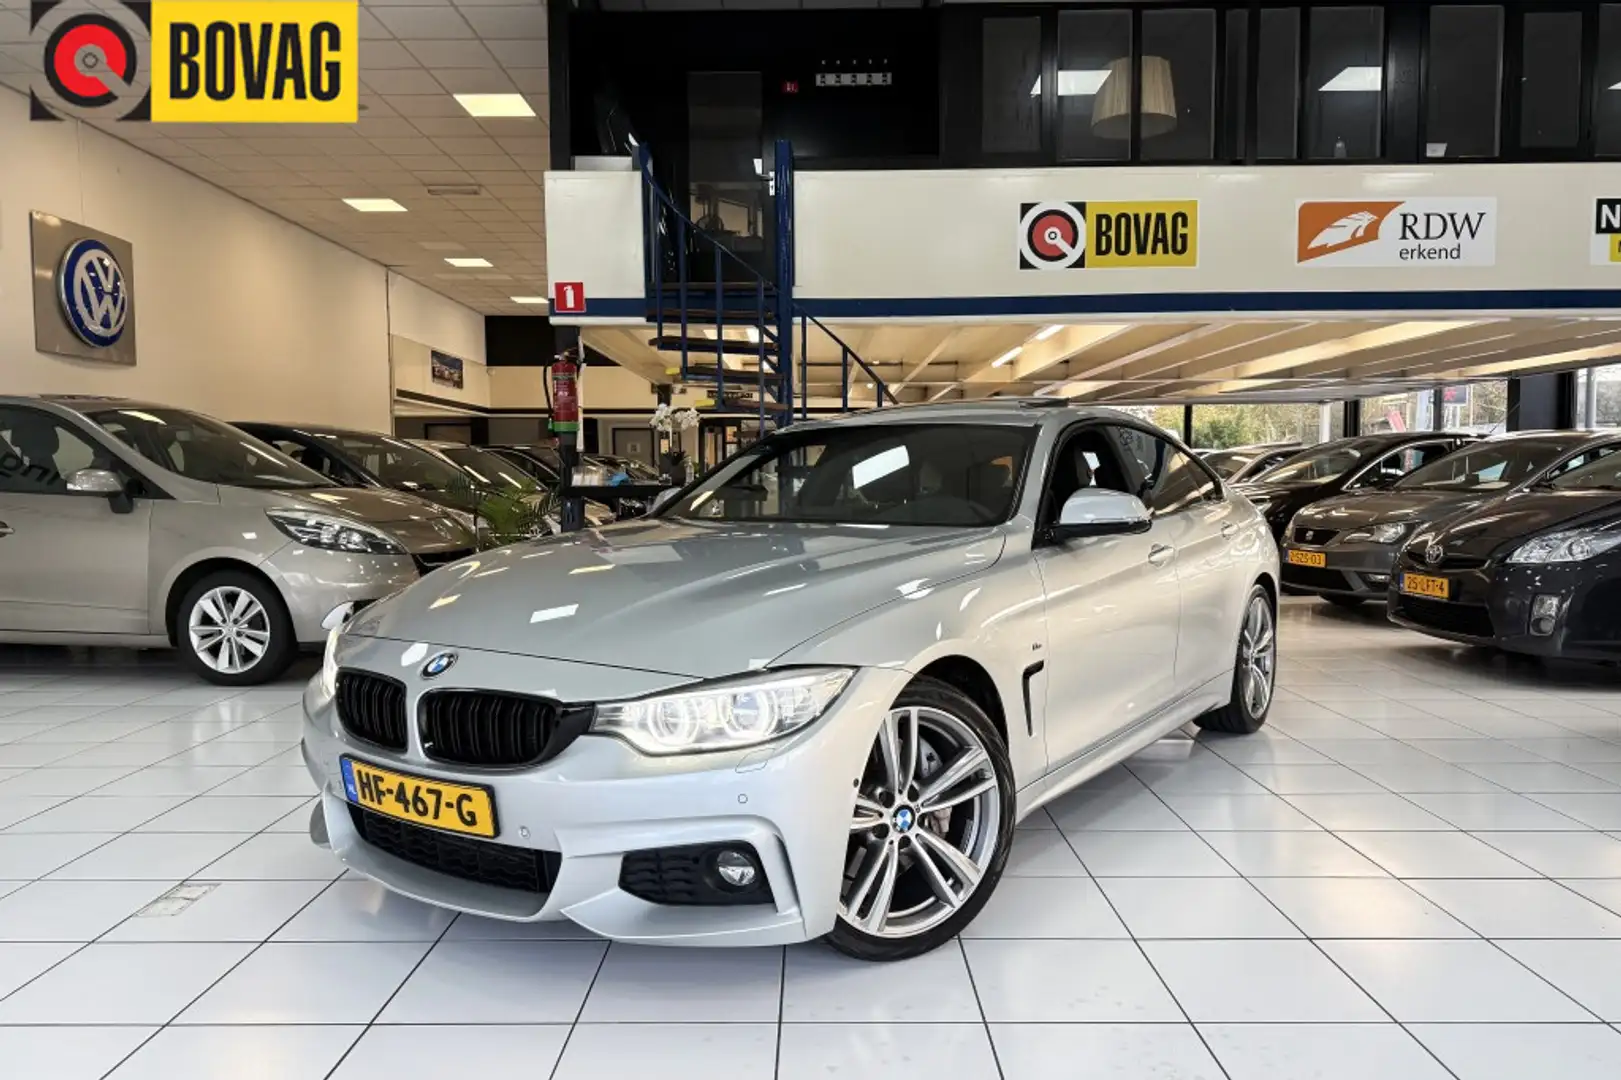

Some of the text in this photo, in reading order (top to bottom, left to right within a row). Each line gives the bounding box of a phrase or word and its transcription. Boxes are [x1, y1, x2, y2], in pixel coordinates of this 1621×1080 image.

[1095, 211, 1189, 256] BOVAG
[1398, 212, 1487, 241] RDW
[1399, 243, 1461, 260] erkend
[356, 769, 478, 827] HF-467-G
